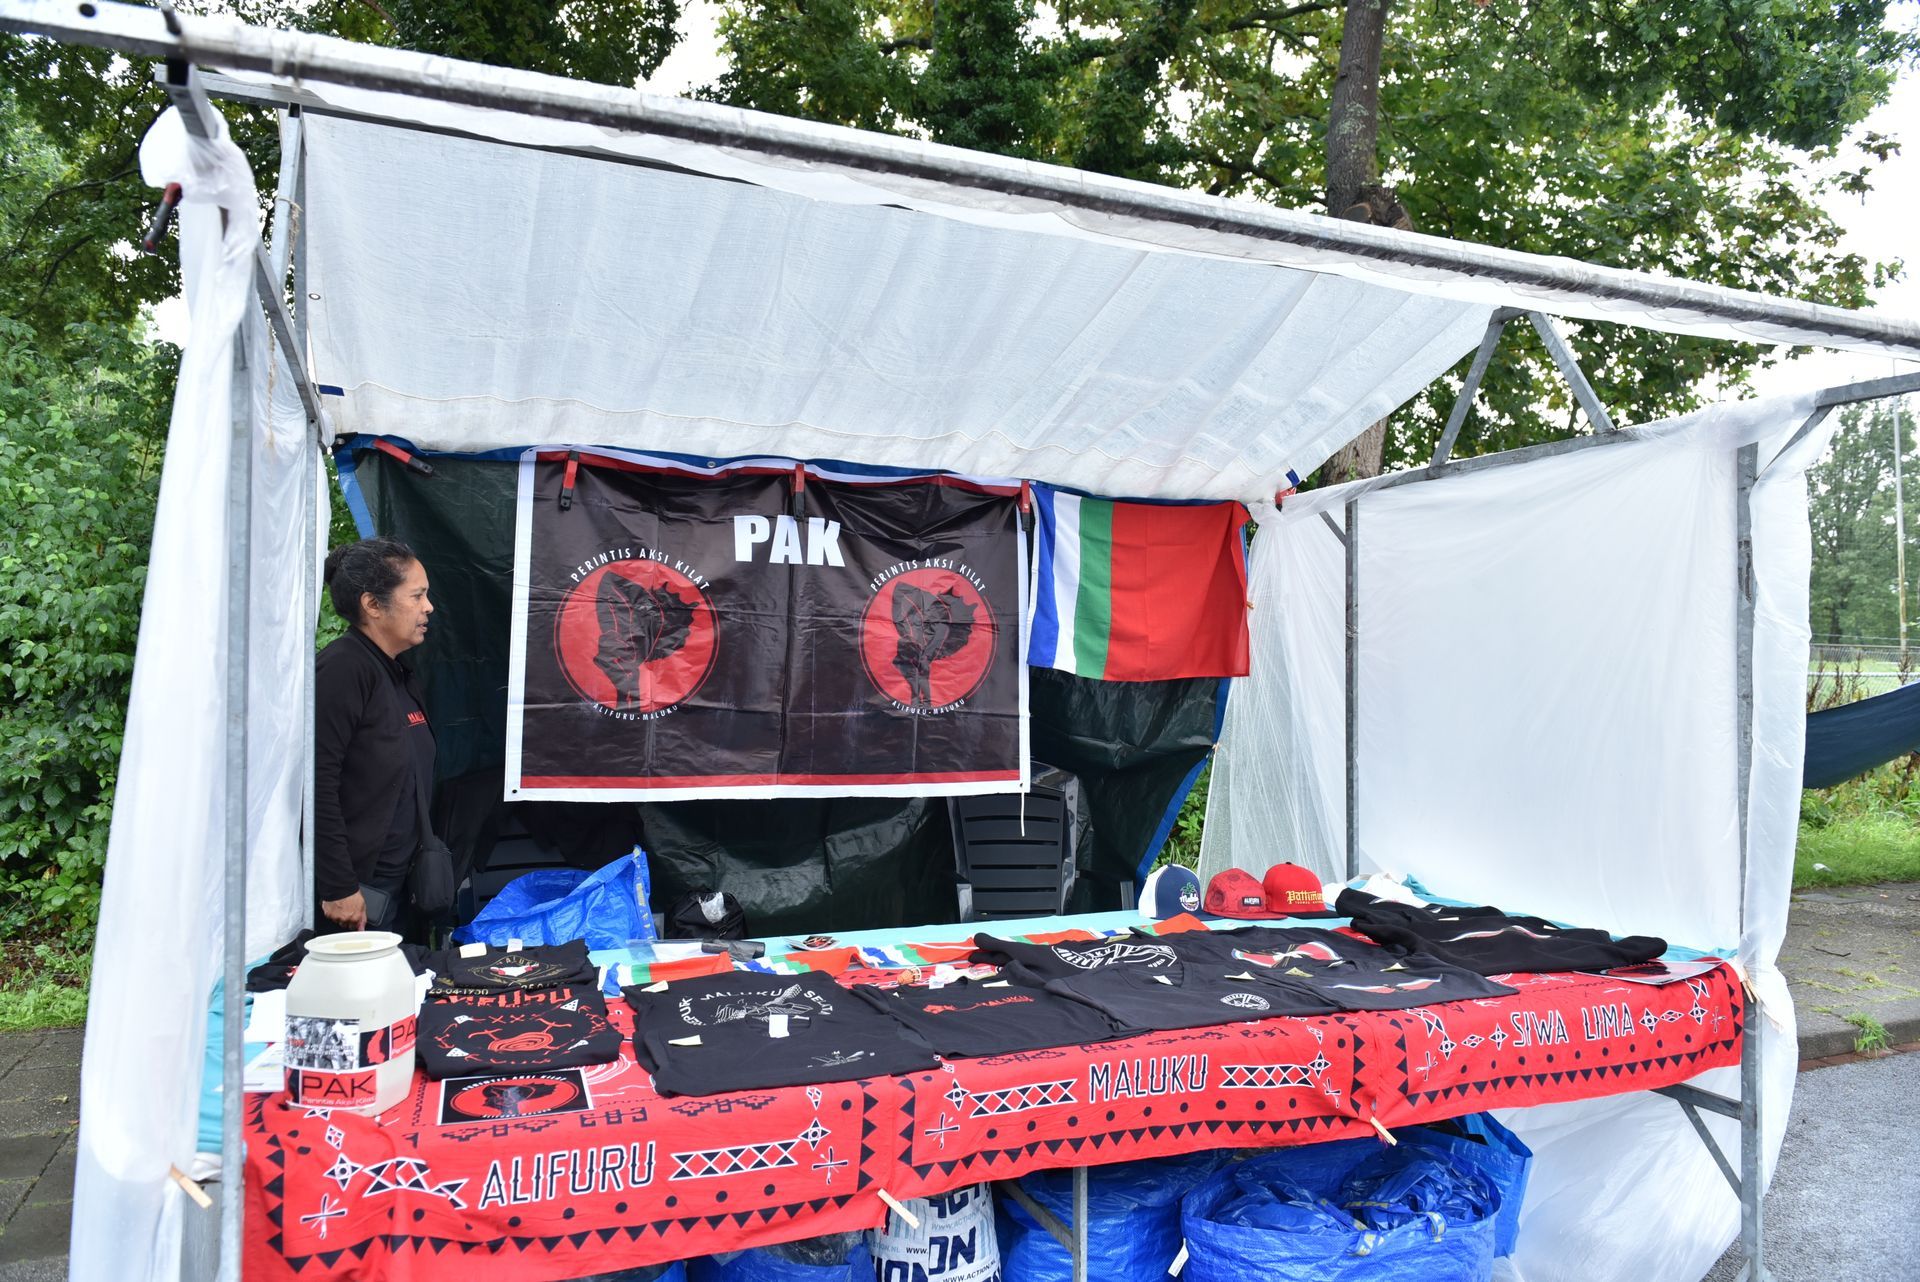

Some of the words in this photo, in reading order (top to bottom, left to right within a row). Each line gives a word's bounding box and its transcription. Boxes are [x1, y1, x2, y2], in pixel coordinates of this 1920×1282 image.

[733, 514, 846, 567] PAK
[570, 547, 631, 583] PERINTIS
[639, 547, 669, 564] AKSI
[674, 559, 710, 590] KILAT
[870, 559, 918, 592] PERINTIS
[924, 558, 954, 570] AKSI
[959, 563, 986, 592] KILAT
[1510, 1009, 1570, 1047] SIWA
[1581, 1002, 1635, 1041] LIMA
[302, 1074, 374, 1098] PAK
[1089, 1054, 1208, 1104] MALUKU
[478, 1141, 656, 1210] ALIFURU
